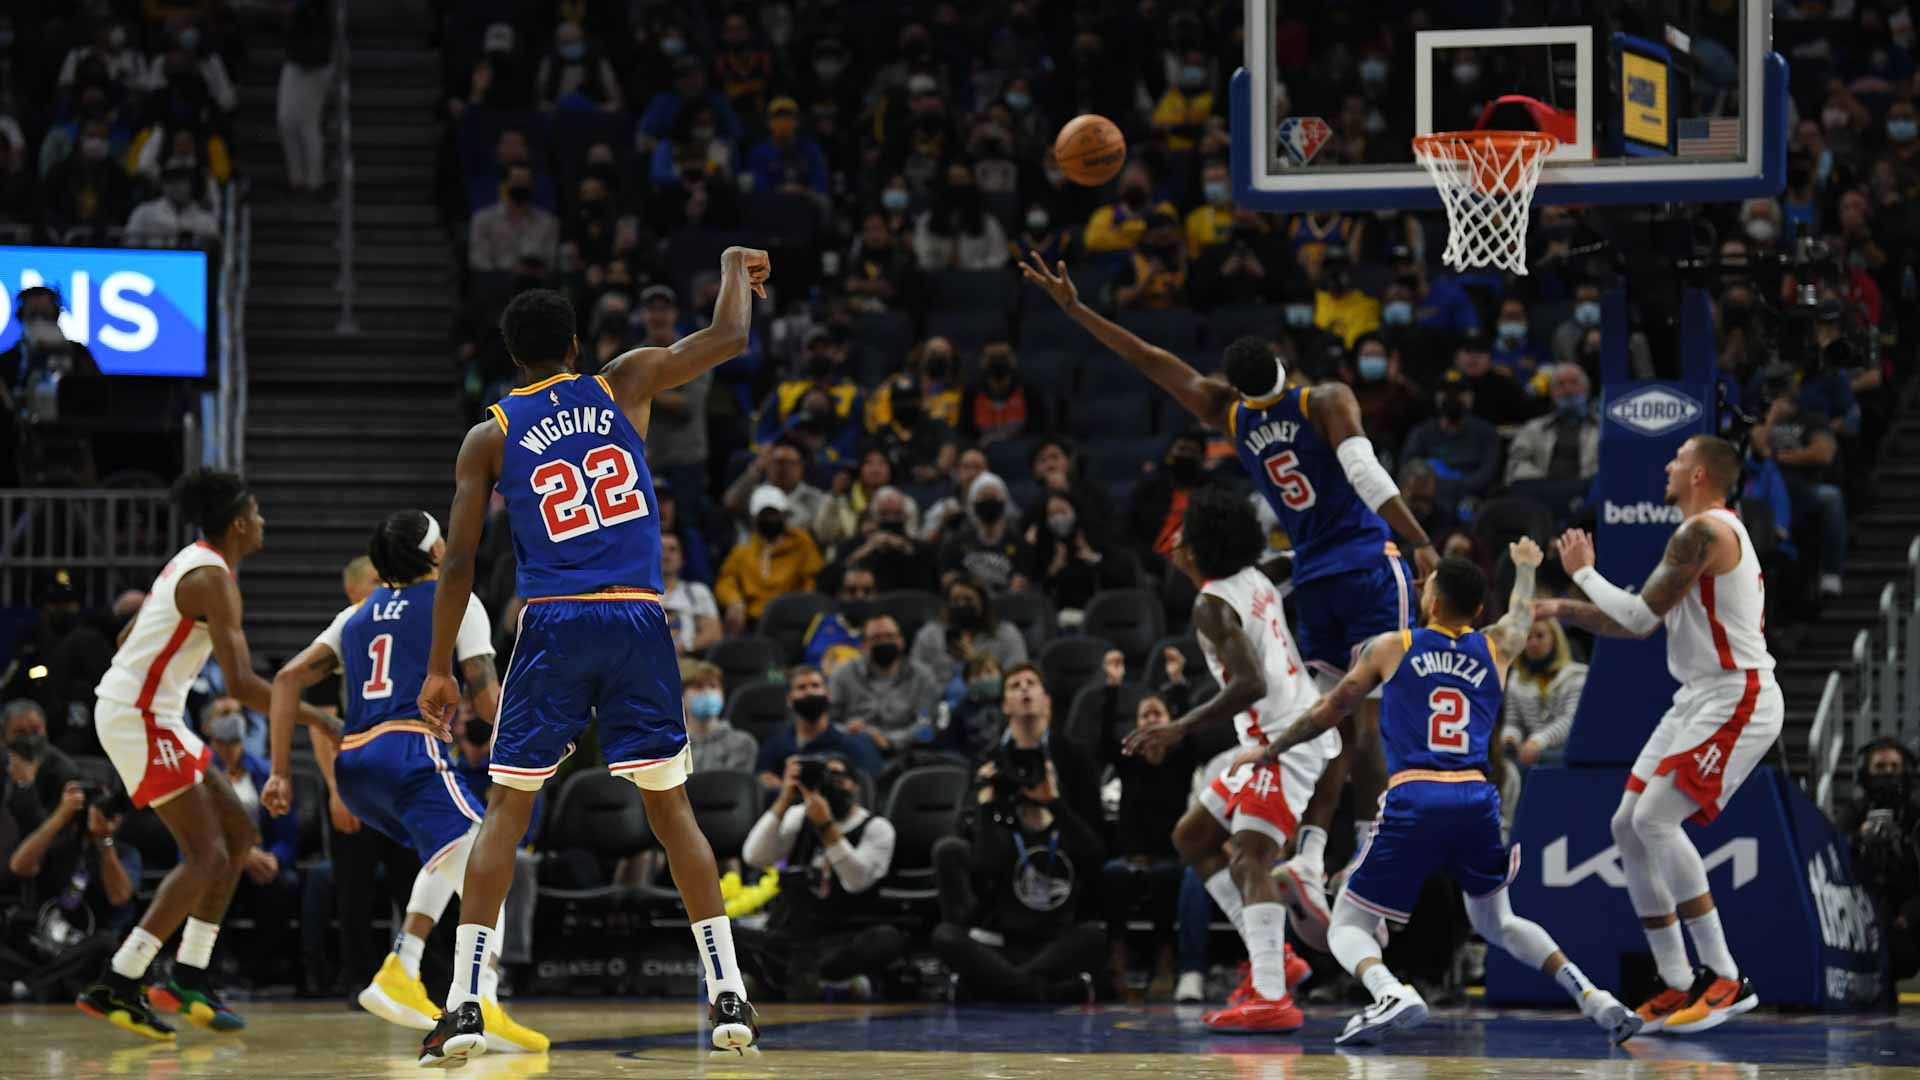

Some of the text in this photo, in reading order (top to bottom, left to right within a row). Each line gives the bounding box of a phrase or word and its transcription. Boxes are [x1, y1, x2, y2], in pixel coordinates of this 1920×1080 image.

[519, 406, 614, 455] WIGGINS
[1618, 400, 1691, 421] CLOROX
[1245, 420, 1300, 456] LOONEY
[530, 443, 649, 543] 22
[1264, 450, 1316, 512] 5
[1605, 499, 1685, 524] betwa
[373, 600, 409, 622] LEE
[362, 633, 394, 700] 1
[1410, 651, 1488, 688] CHIOZZA
[1427, 686, 1470, 754] 2
